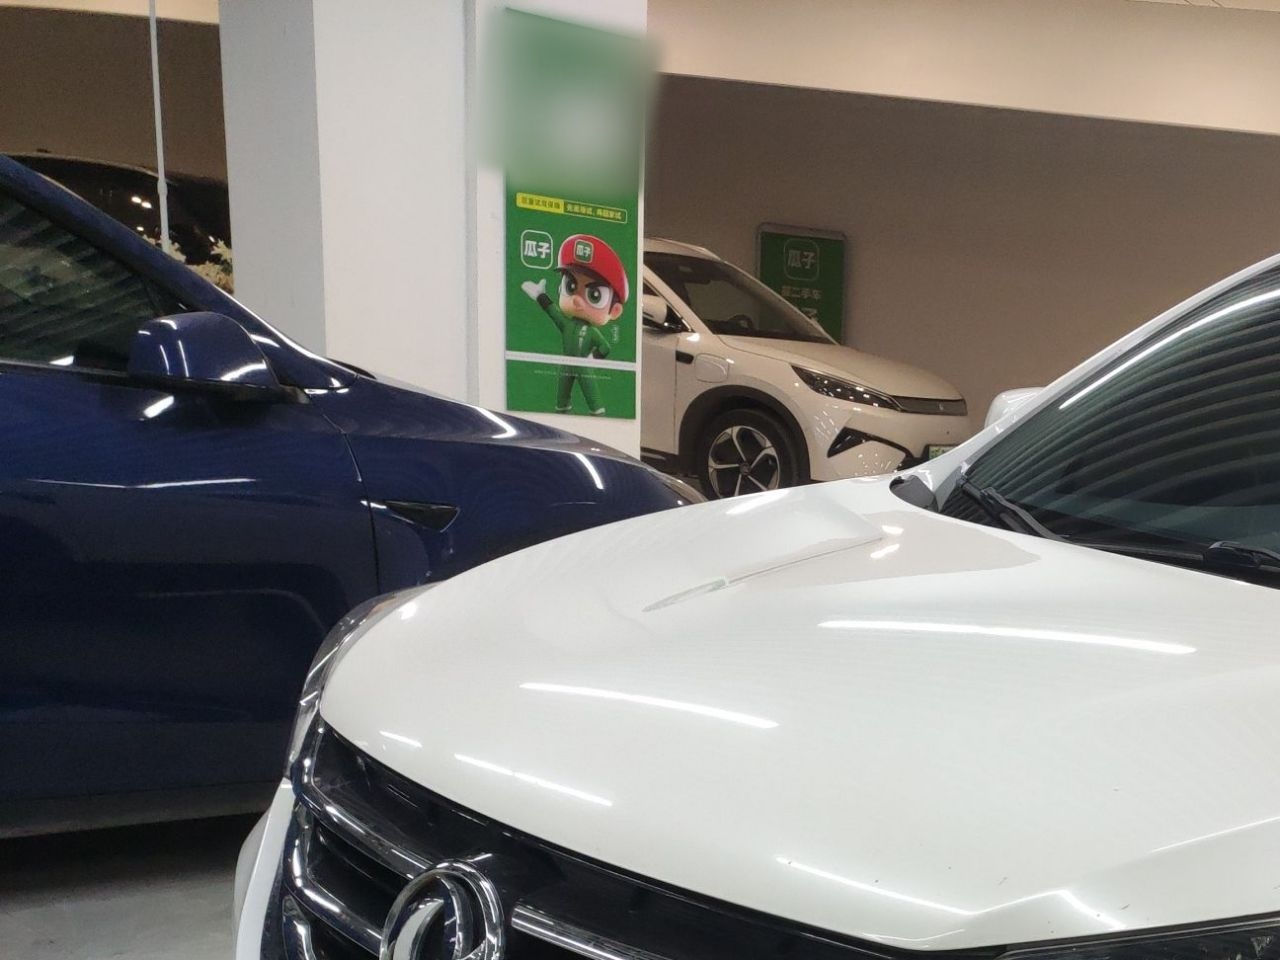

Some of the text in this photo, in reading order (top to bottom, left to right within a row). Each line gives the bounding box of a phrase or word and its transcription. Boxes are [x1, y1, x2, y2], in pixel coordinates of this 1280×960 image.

[524, 240, 550, 259] 瓜子
[576, 244, 591, 258] 瓜子
[788, 249, 815, 270] 瓜子
